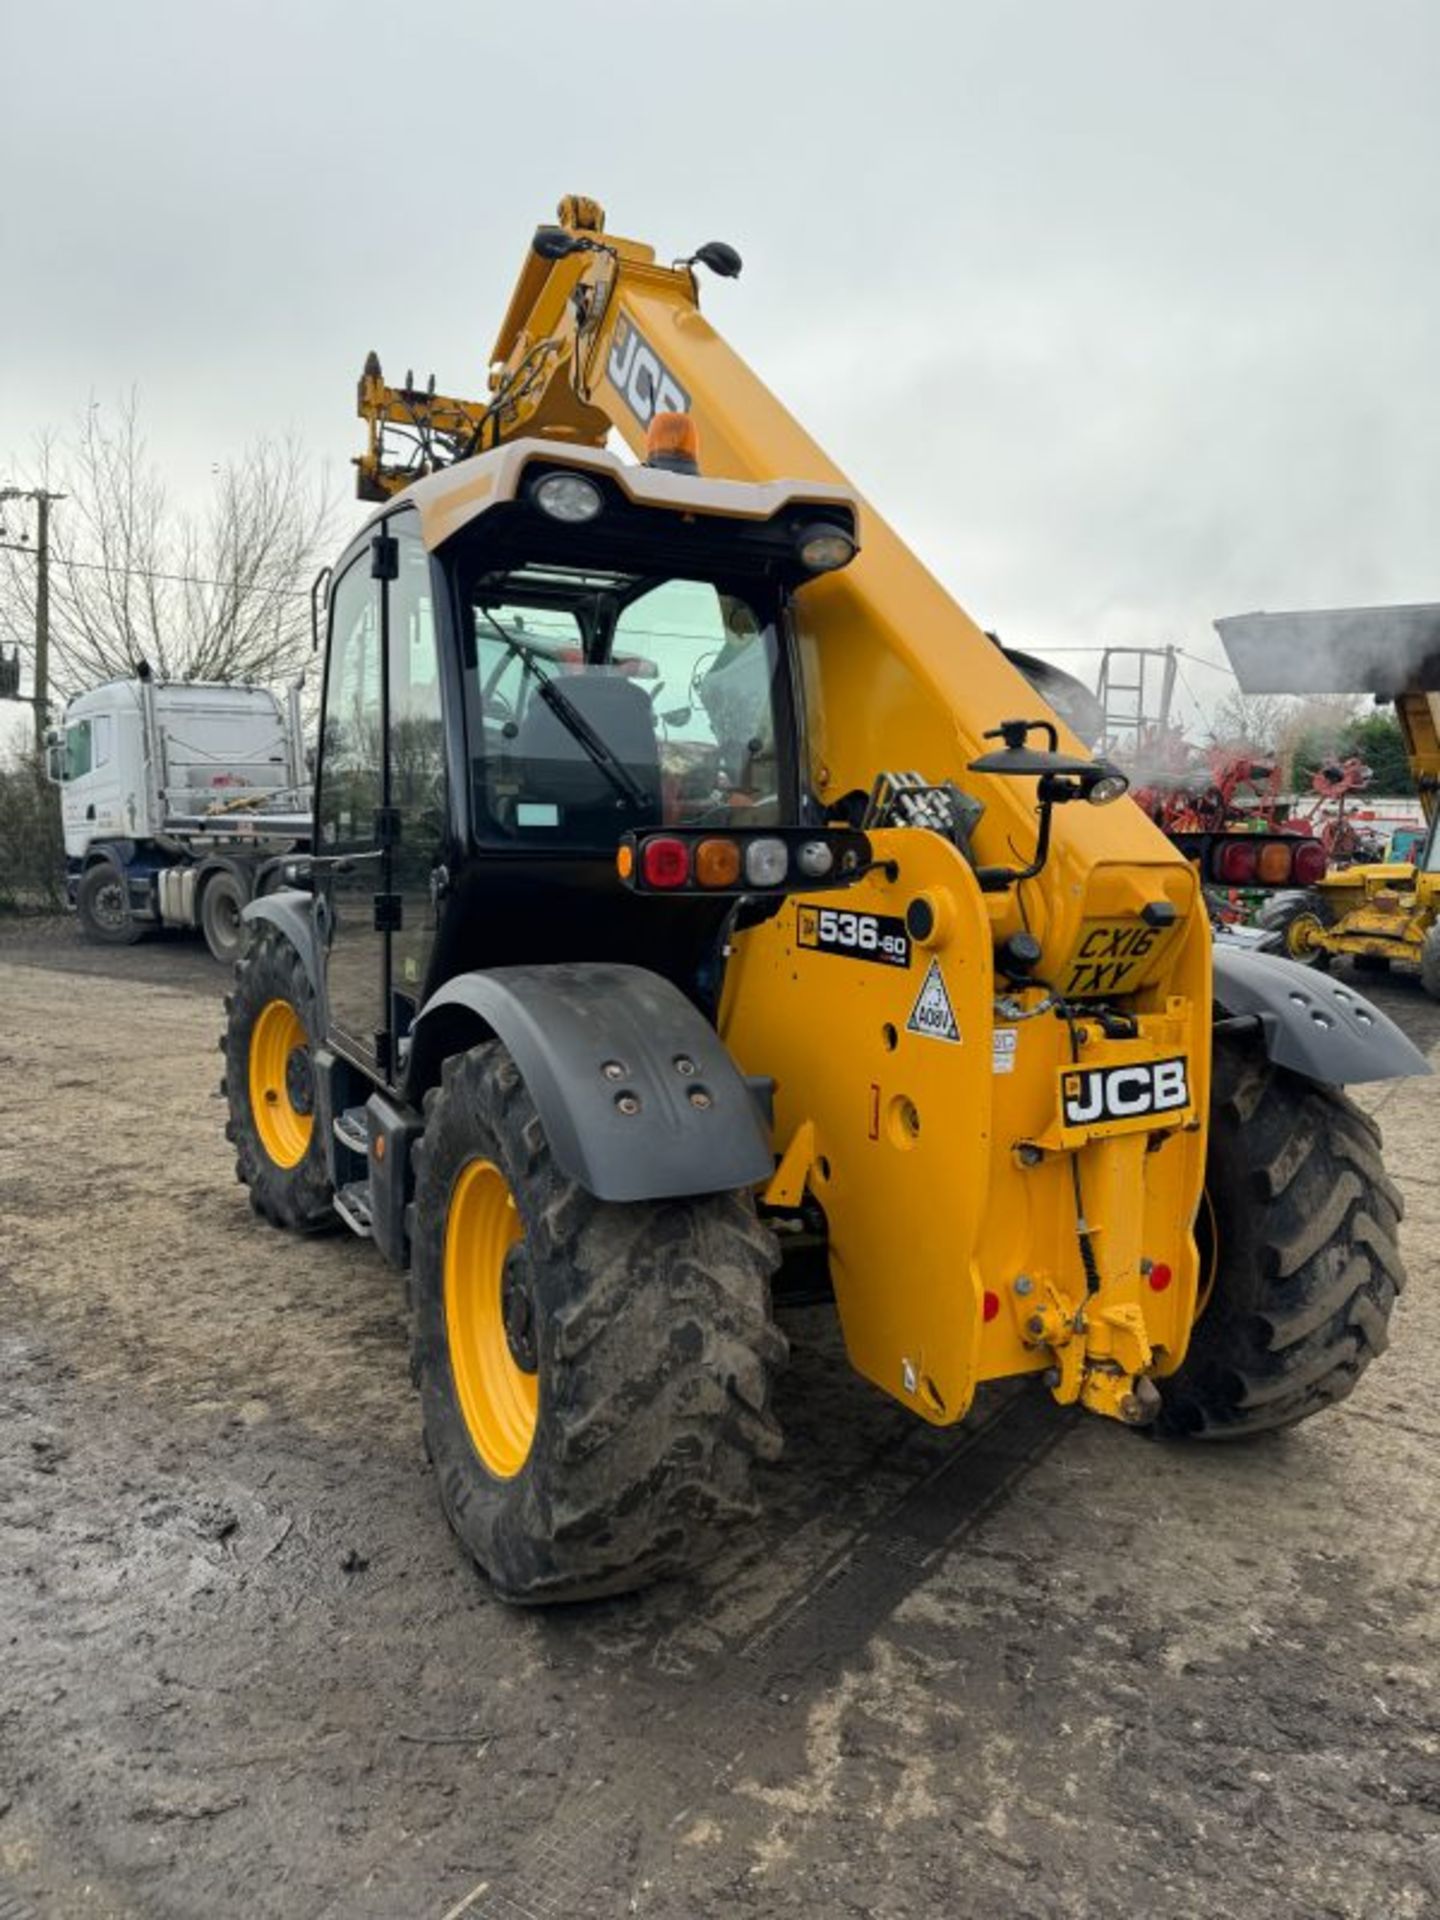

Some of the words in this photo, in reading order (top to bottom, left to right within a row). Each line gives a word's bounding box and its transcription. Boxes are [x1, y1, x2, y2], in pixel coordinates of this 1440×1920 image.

[820, 911, 906, 955] 536-60
[1079, 928, 1161, 958] CX16
[1067, 962, 1135, 992] TXY
[1066, 1060, 1187, 1122] JCB
